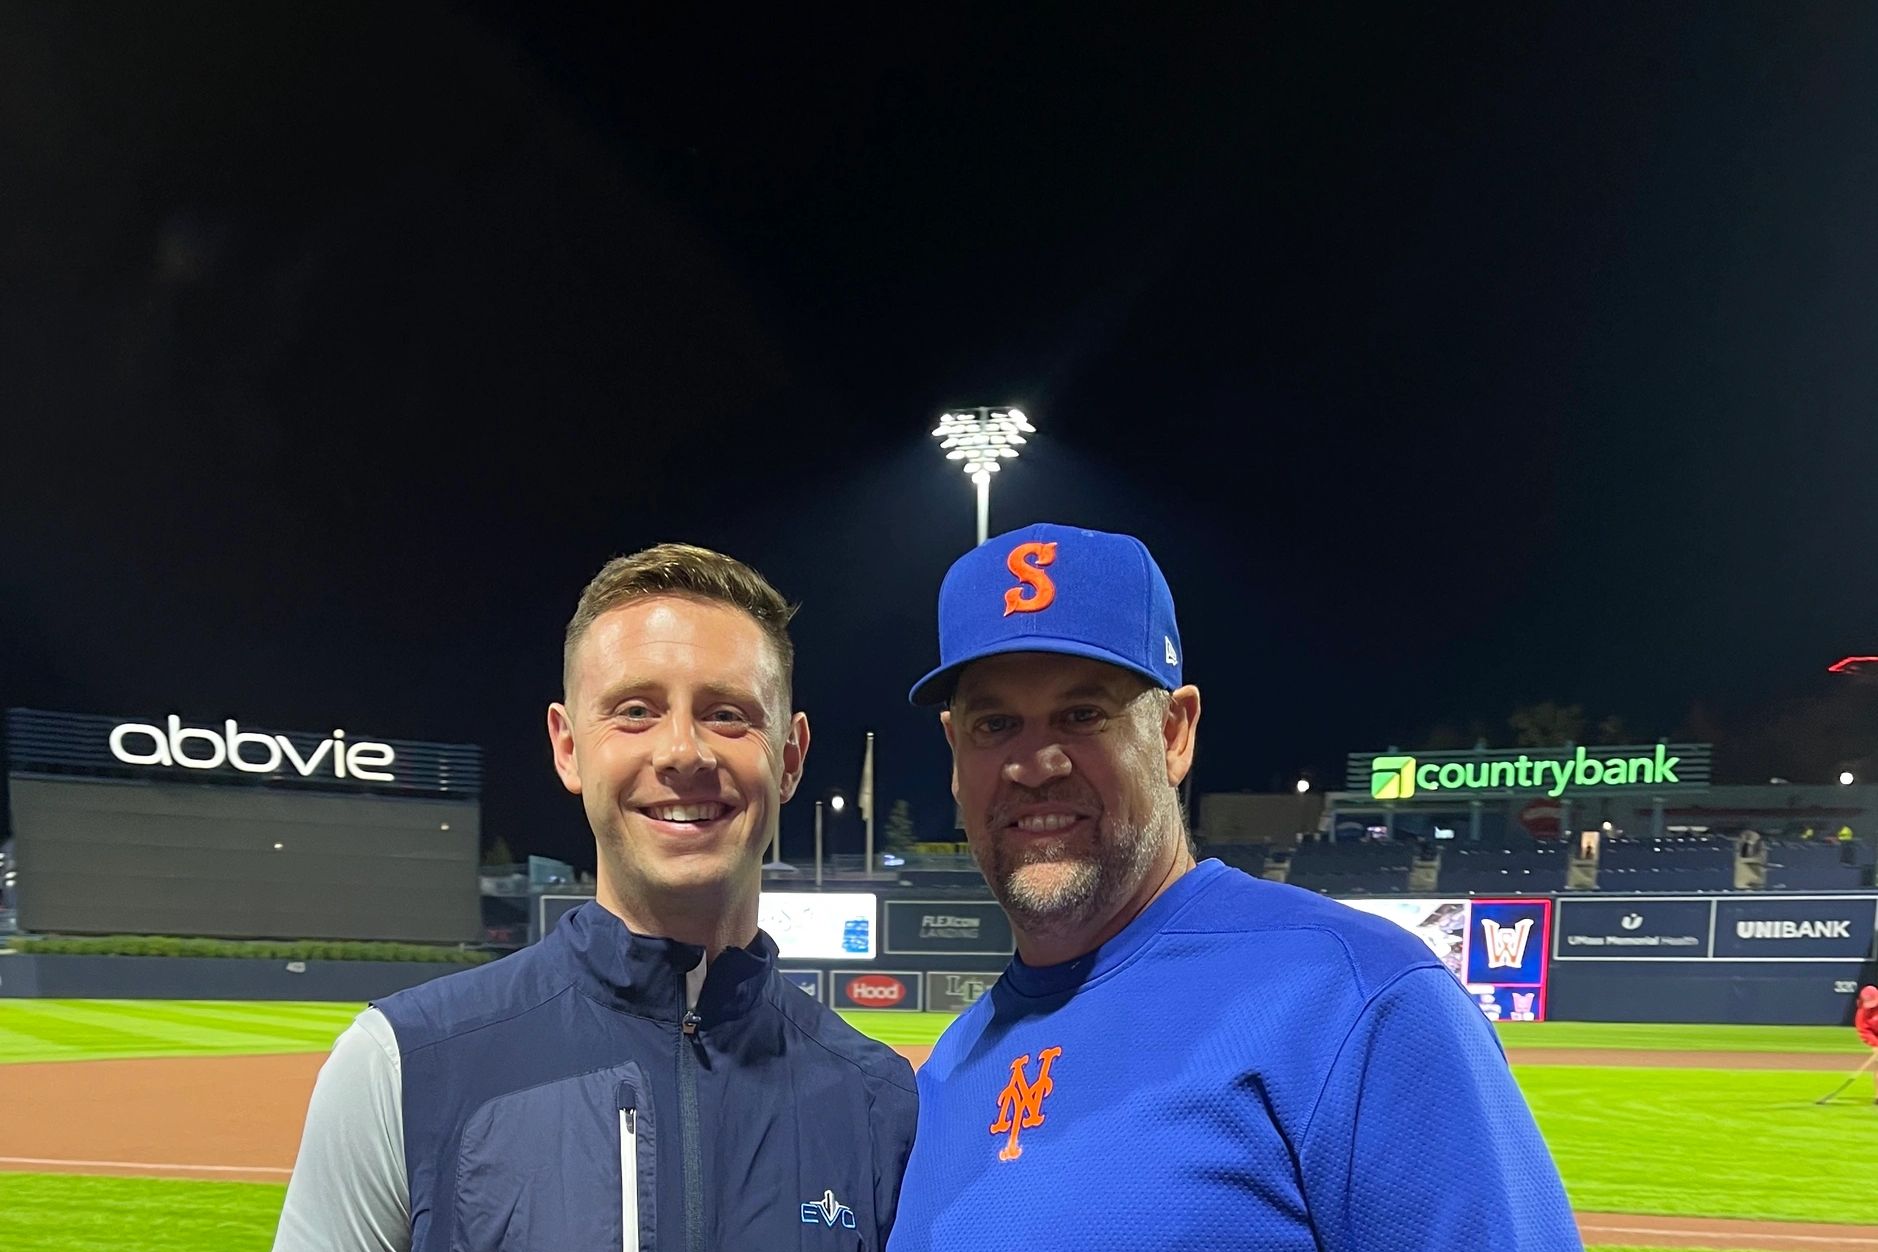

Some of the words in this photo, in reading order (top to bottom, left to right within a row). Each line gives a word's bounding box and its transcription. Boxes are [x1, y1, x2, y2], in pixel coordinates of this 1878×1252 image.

[1004, 542, 1057, 616] S
[109, 714, 395, 781] abbvie
[1416, 744, 1680, 797] countrybank
[1481, 918, 1534, 968] W
[1737, 920, 1850, 938] UNIBANK
[853, 982, 899, 999] Hood
[990, 1046, 1062, 1160] NY
[801, 1203, 856, 1228] EVO
